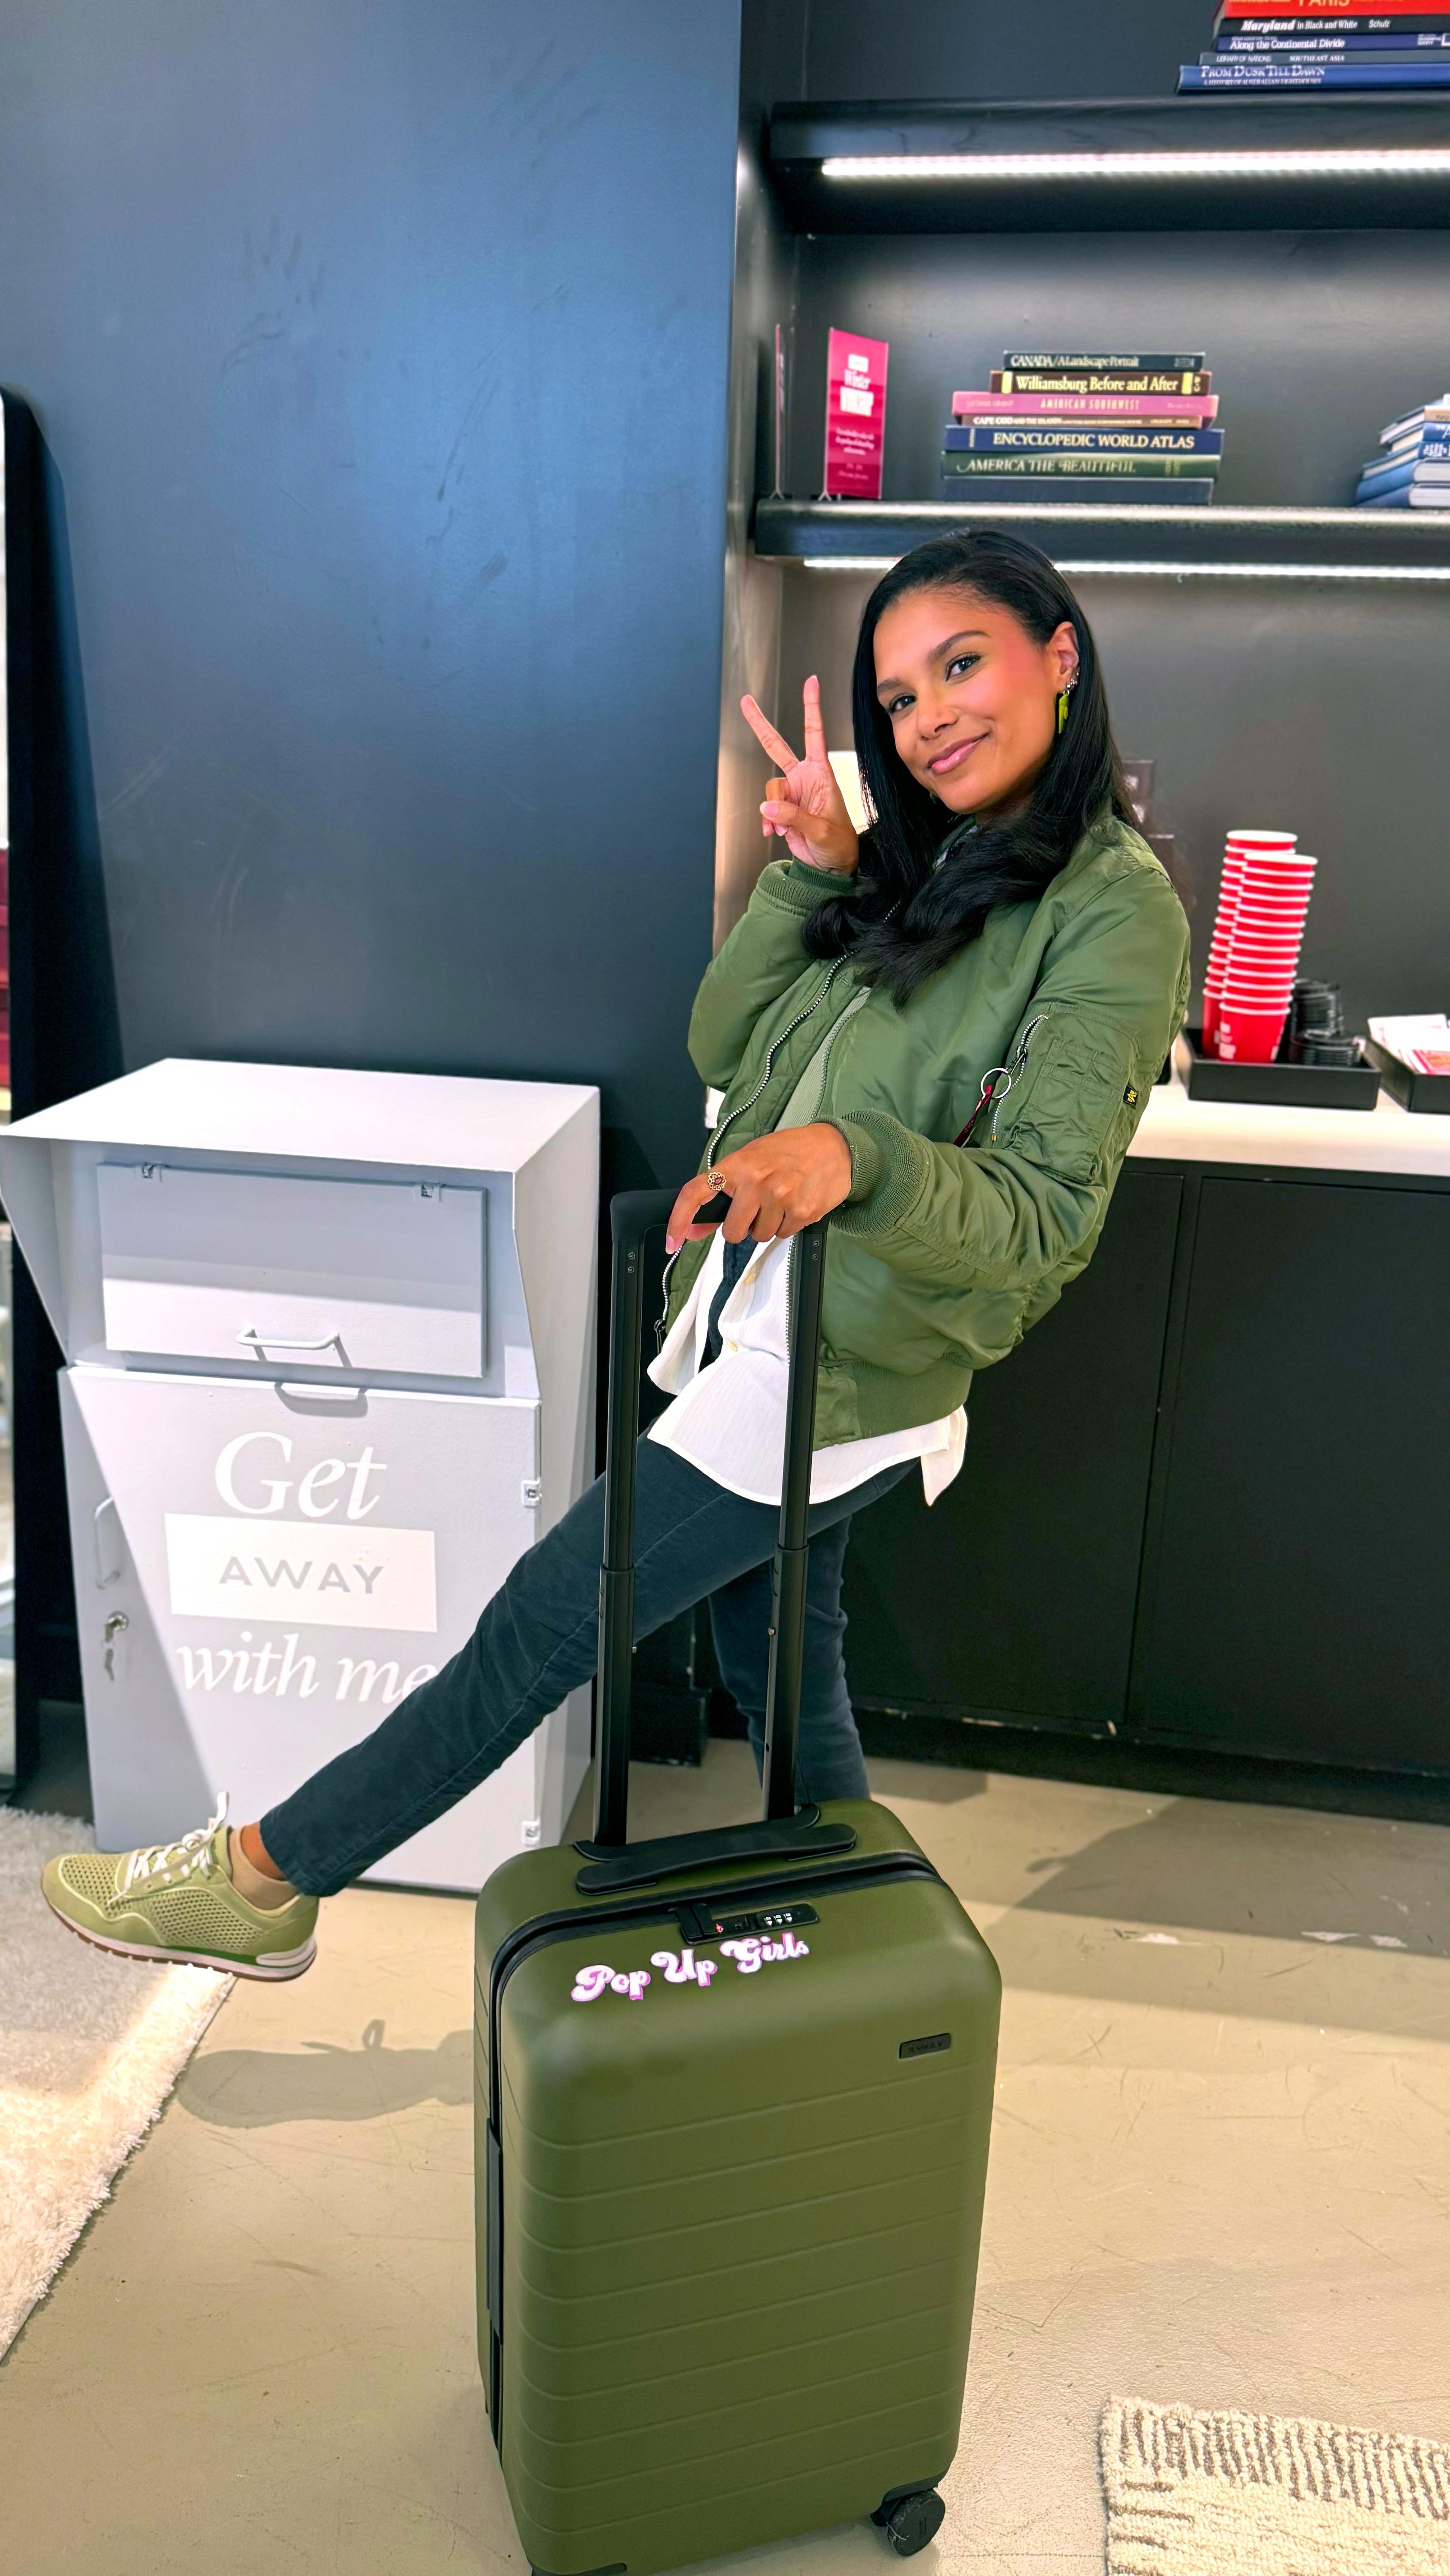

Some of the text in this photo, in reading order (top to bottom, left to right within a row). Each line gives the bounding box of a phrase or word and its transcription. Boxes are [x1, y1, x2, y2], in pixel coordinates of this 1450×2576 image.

[1241, 19, 1296, 33] Maryland
[1297, 21, 1304, 29] in
[1305, 20, 1324, 29] Black
[1324, 21, 1337, 29] and
[1338, 20, 1358, 29] White
[1230, 39, 1345, 51] Along the Continental Divide
[1201, 65, 1325, 77] FROM DUSK TILL DAWN
[1016, 375, 1179, 394] Williamsburg Before and After
[1040, 398, 1086, 409] AMERICAN
[1089, 399, 1140, 410] SOUTHWEST
[973, 417, 995, 425] CAPE
[995, 417, 1013, 425] COD
[993, 432, 1194, 449] ENCYCLOPEDIC WORLD ATLAS
[956, 459, 1137, 473] AMERICA THE BEAUTIFUL
[215, 1431, 387, 1520] Get
[219, 1556, 384, 1594] AWAY
[175, 1630, 439, 1704] with me
[570, 1932, 810, 2002] Pop Up Girls
